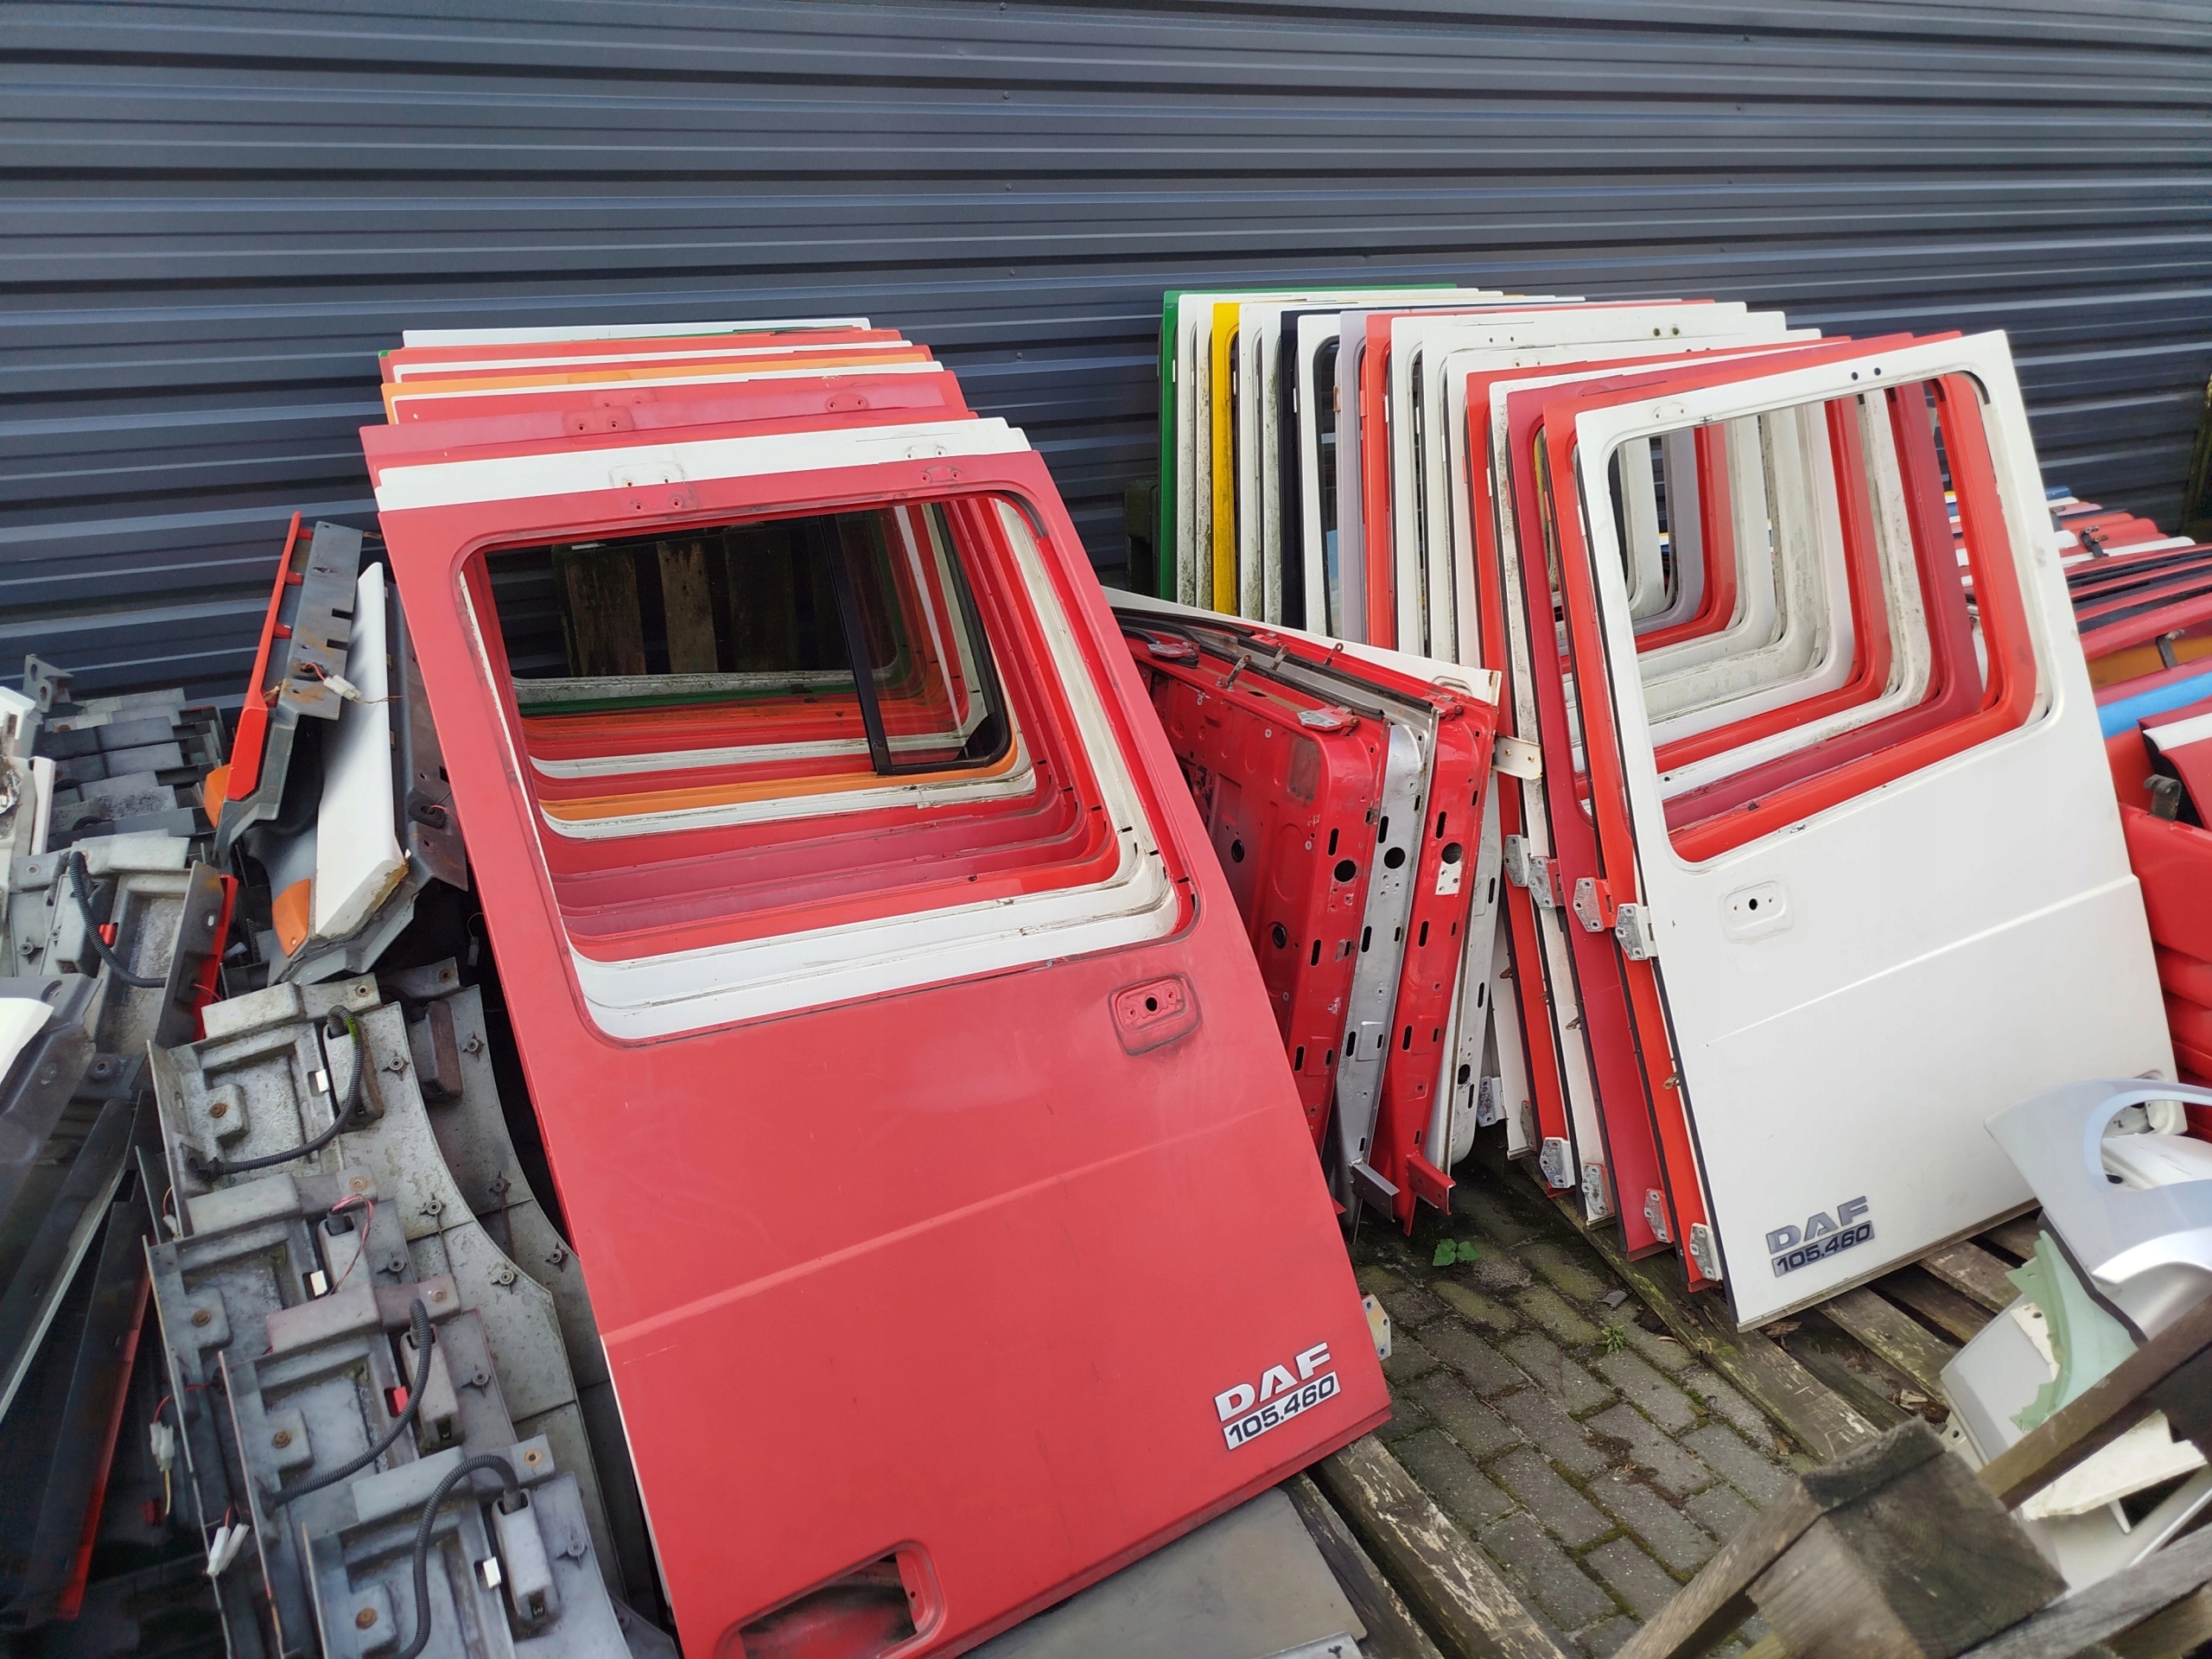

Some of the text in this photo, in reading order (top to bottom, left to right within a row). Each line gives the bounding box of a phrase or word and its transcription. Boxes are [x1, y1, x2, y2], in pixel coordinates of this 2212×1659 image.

[1766, 1196, 1868, 1254] DAF
[1777, 1224, 1870, 1272] 105.460
[1213, 1341, 1331, 1422] DAF
[1229, 1376, 1333, 1442] 105.460
